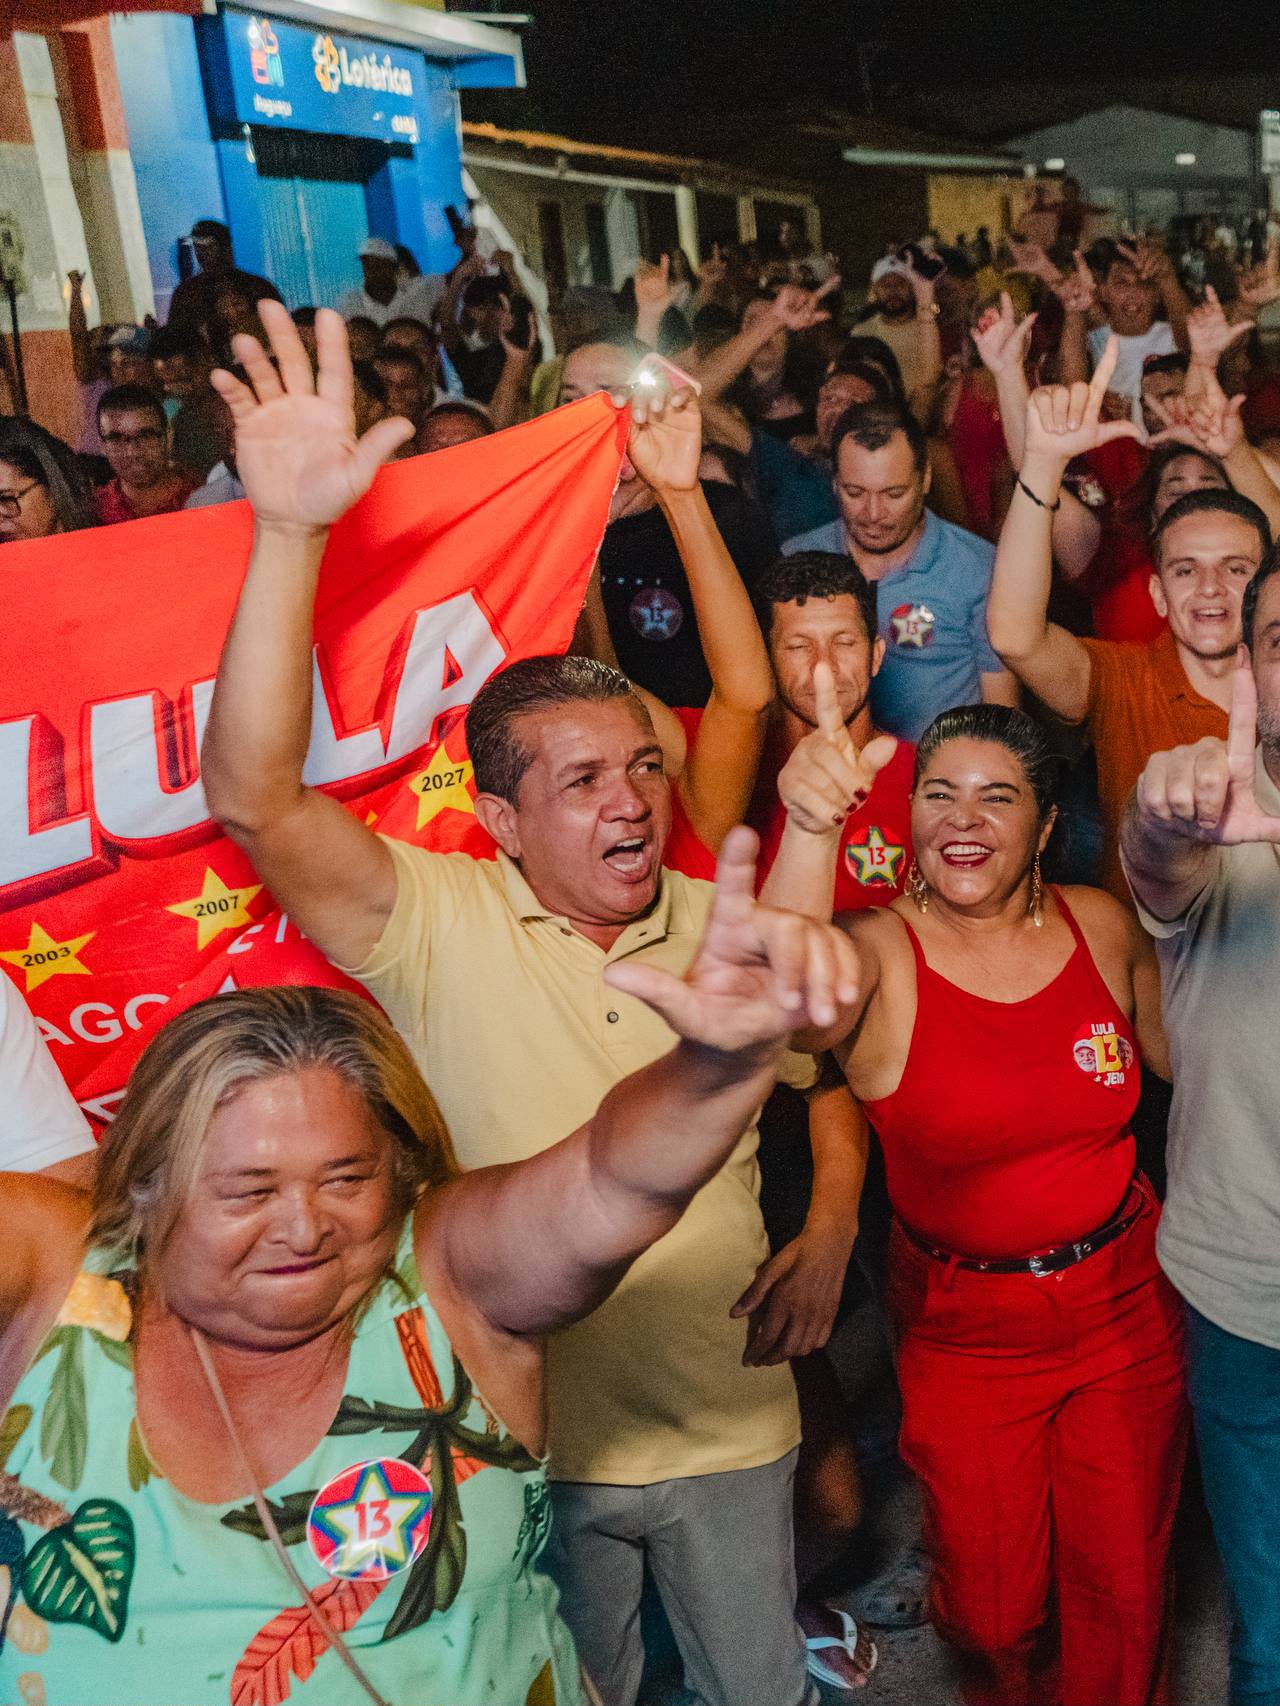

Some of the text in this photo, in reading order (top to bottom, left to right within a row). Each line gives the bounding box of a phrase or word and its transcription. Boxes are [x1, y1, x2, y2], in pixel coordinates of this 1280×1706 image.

[0, 588, 509, 889] LULA
[420, 768, 466, 792] 2027
[867, 846, 886, 865] 13
[193, 895, 240, 918] 2007
[21, 946, 72, 968] 2003
[1090, 1022, 1115, 1036] LULA
[1090, 1033, 1123, 1073] 13
[354, 1499, 391, 1541] 13
